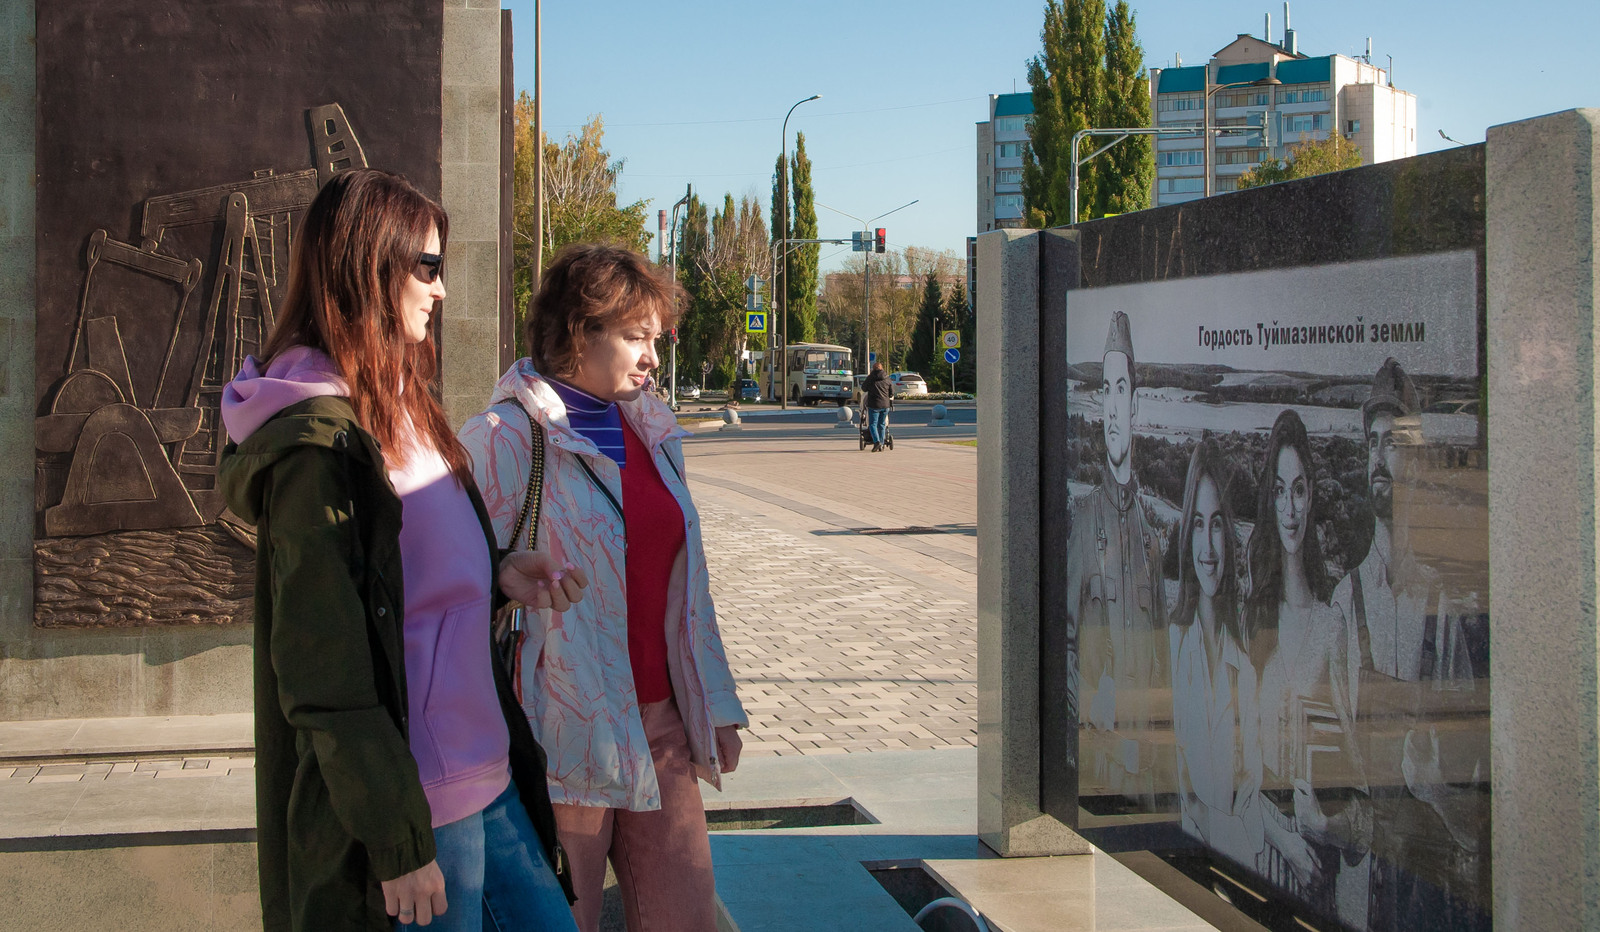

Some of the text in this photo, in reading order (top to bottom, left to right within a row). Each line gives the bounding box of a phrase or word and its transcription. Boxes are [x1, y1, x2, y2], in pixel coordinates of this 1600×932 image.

[1198, 316, 1425, 350] Гордость Туймазинской земли
